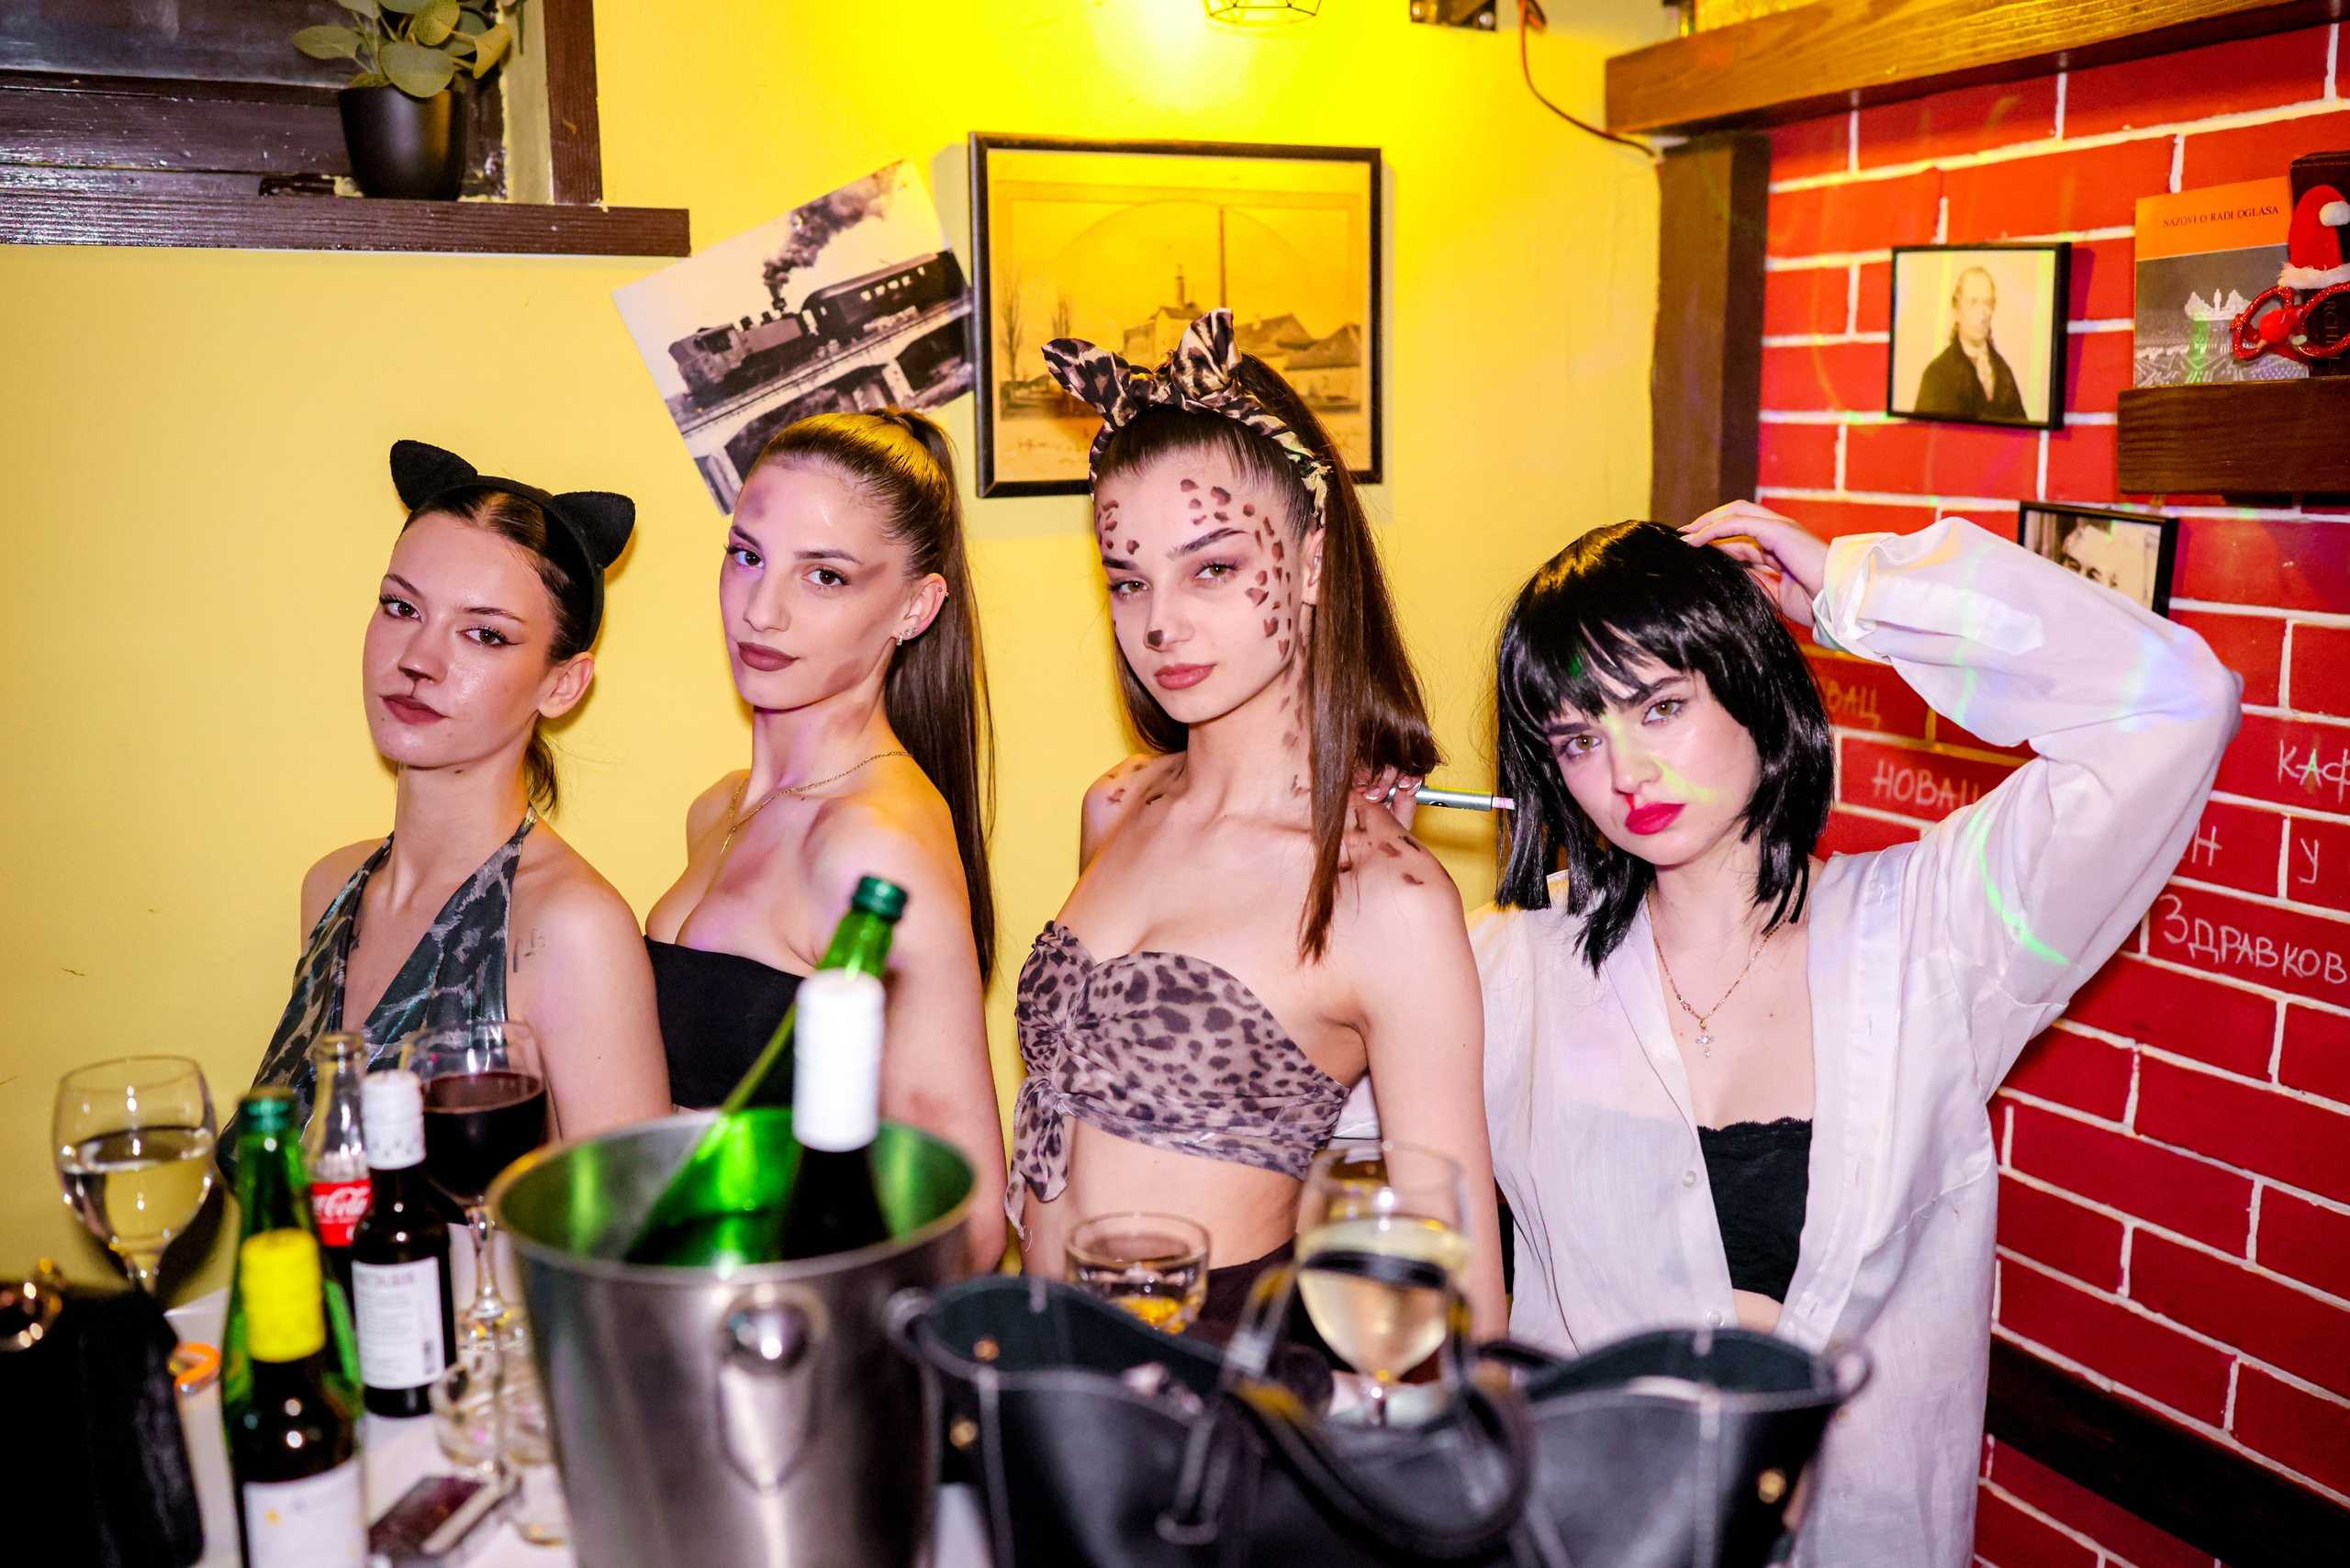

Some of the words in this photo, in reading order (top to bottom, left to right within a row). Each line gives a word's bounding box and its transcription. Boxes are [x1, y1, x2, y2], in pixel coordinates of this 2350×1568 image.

[2163, 215, 2197, 229] NAZOVI
[2210, 210, 2233, 222] RADI
[2237, 206, 2278, 219] OGLASA
[2158, 893, 2348, 985] ЗДРАВКОВ
